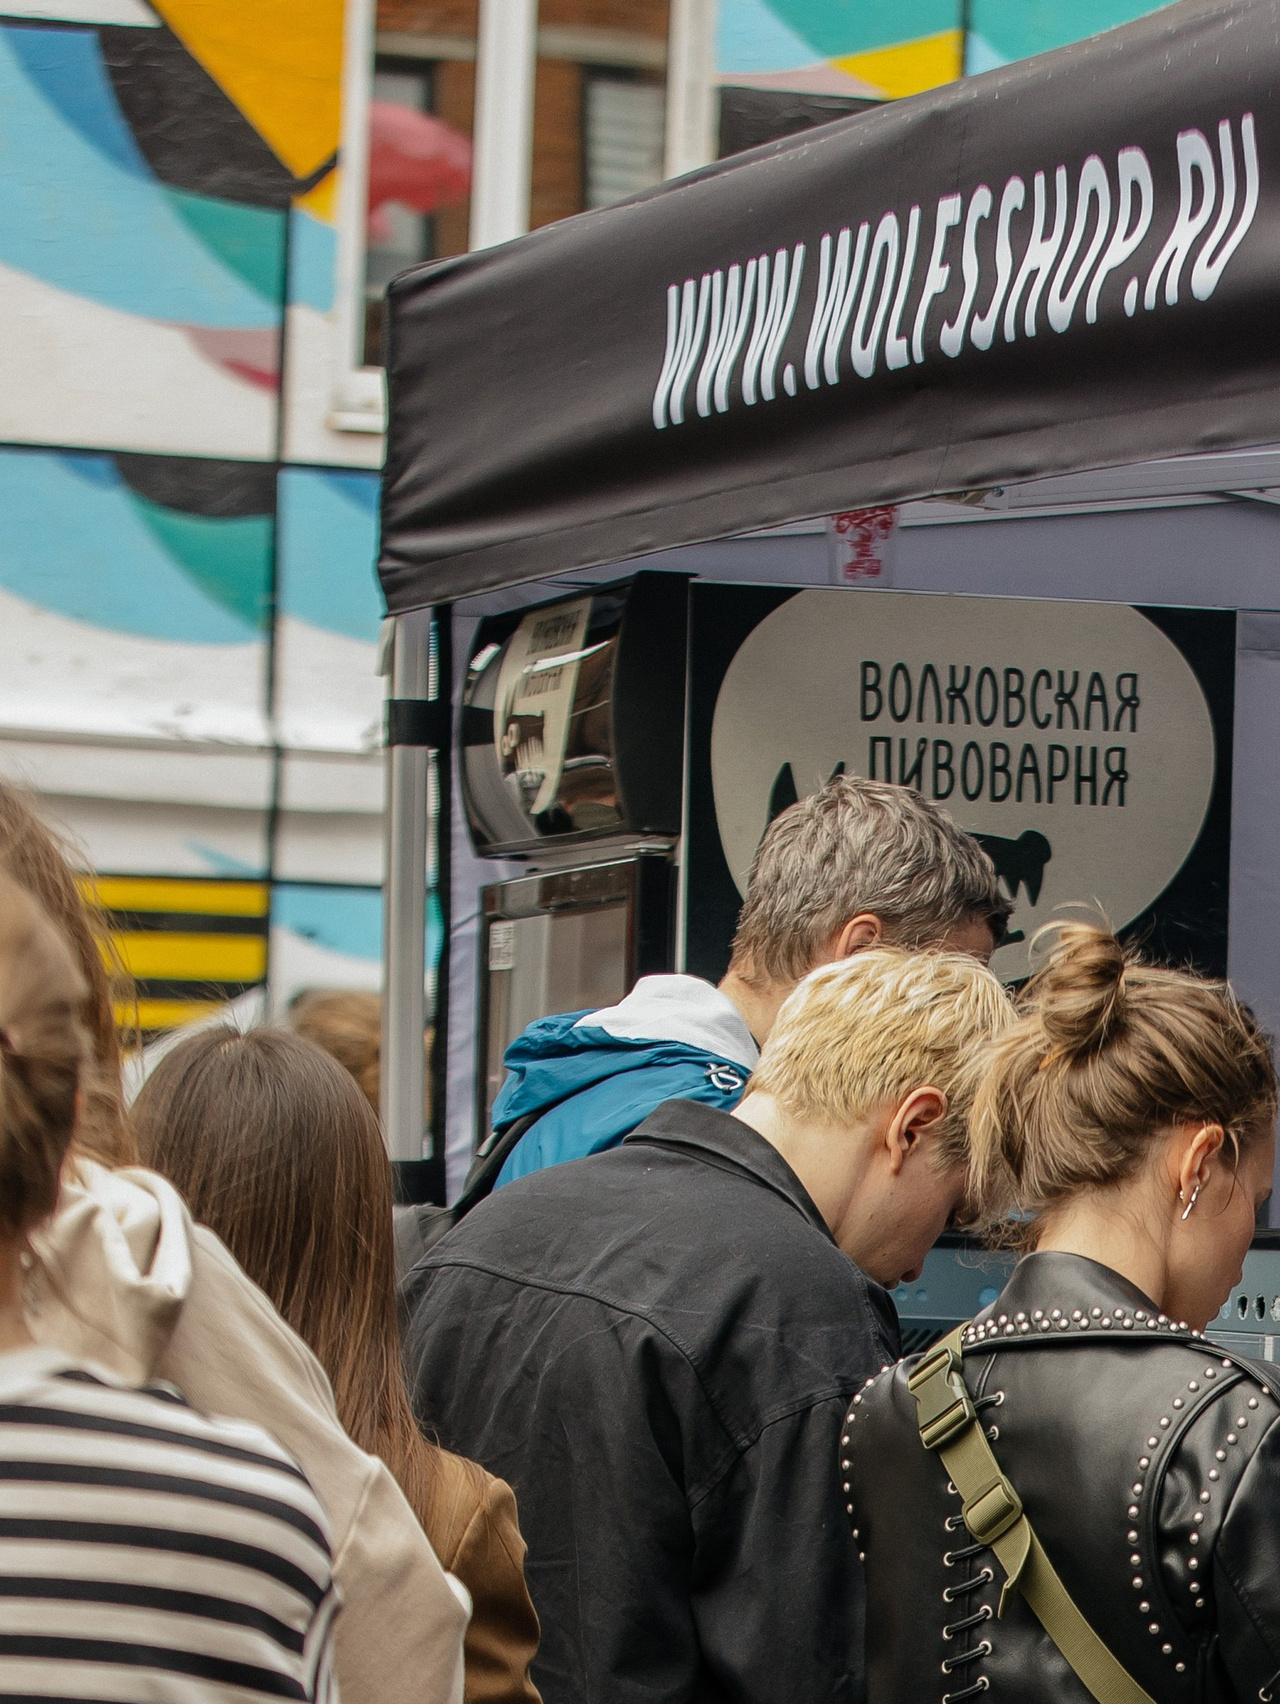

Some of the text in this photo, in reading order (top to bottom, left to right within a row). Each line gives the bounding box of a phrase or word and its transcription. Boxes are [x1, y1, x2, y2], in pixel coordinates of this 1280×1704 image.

[652, 112, 1260, 429] WWW.WOLFSSHOP.RU
[860, 660, 1141, 733] ВОЛКОВСКАЯ
[868, 736, 1129, 807] ПИВОВАРНЯ
